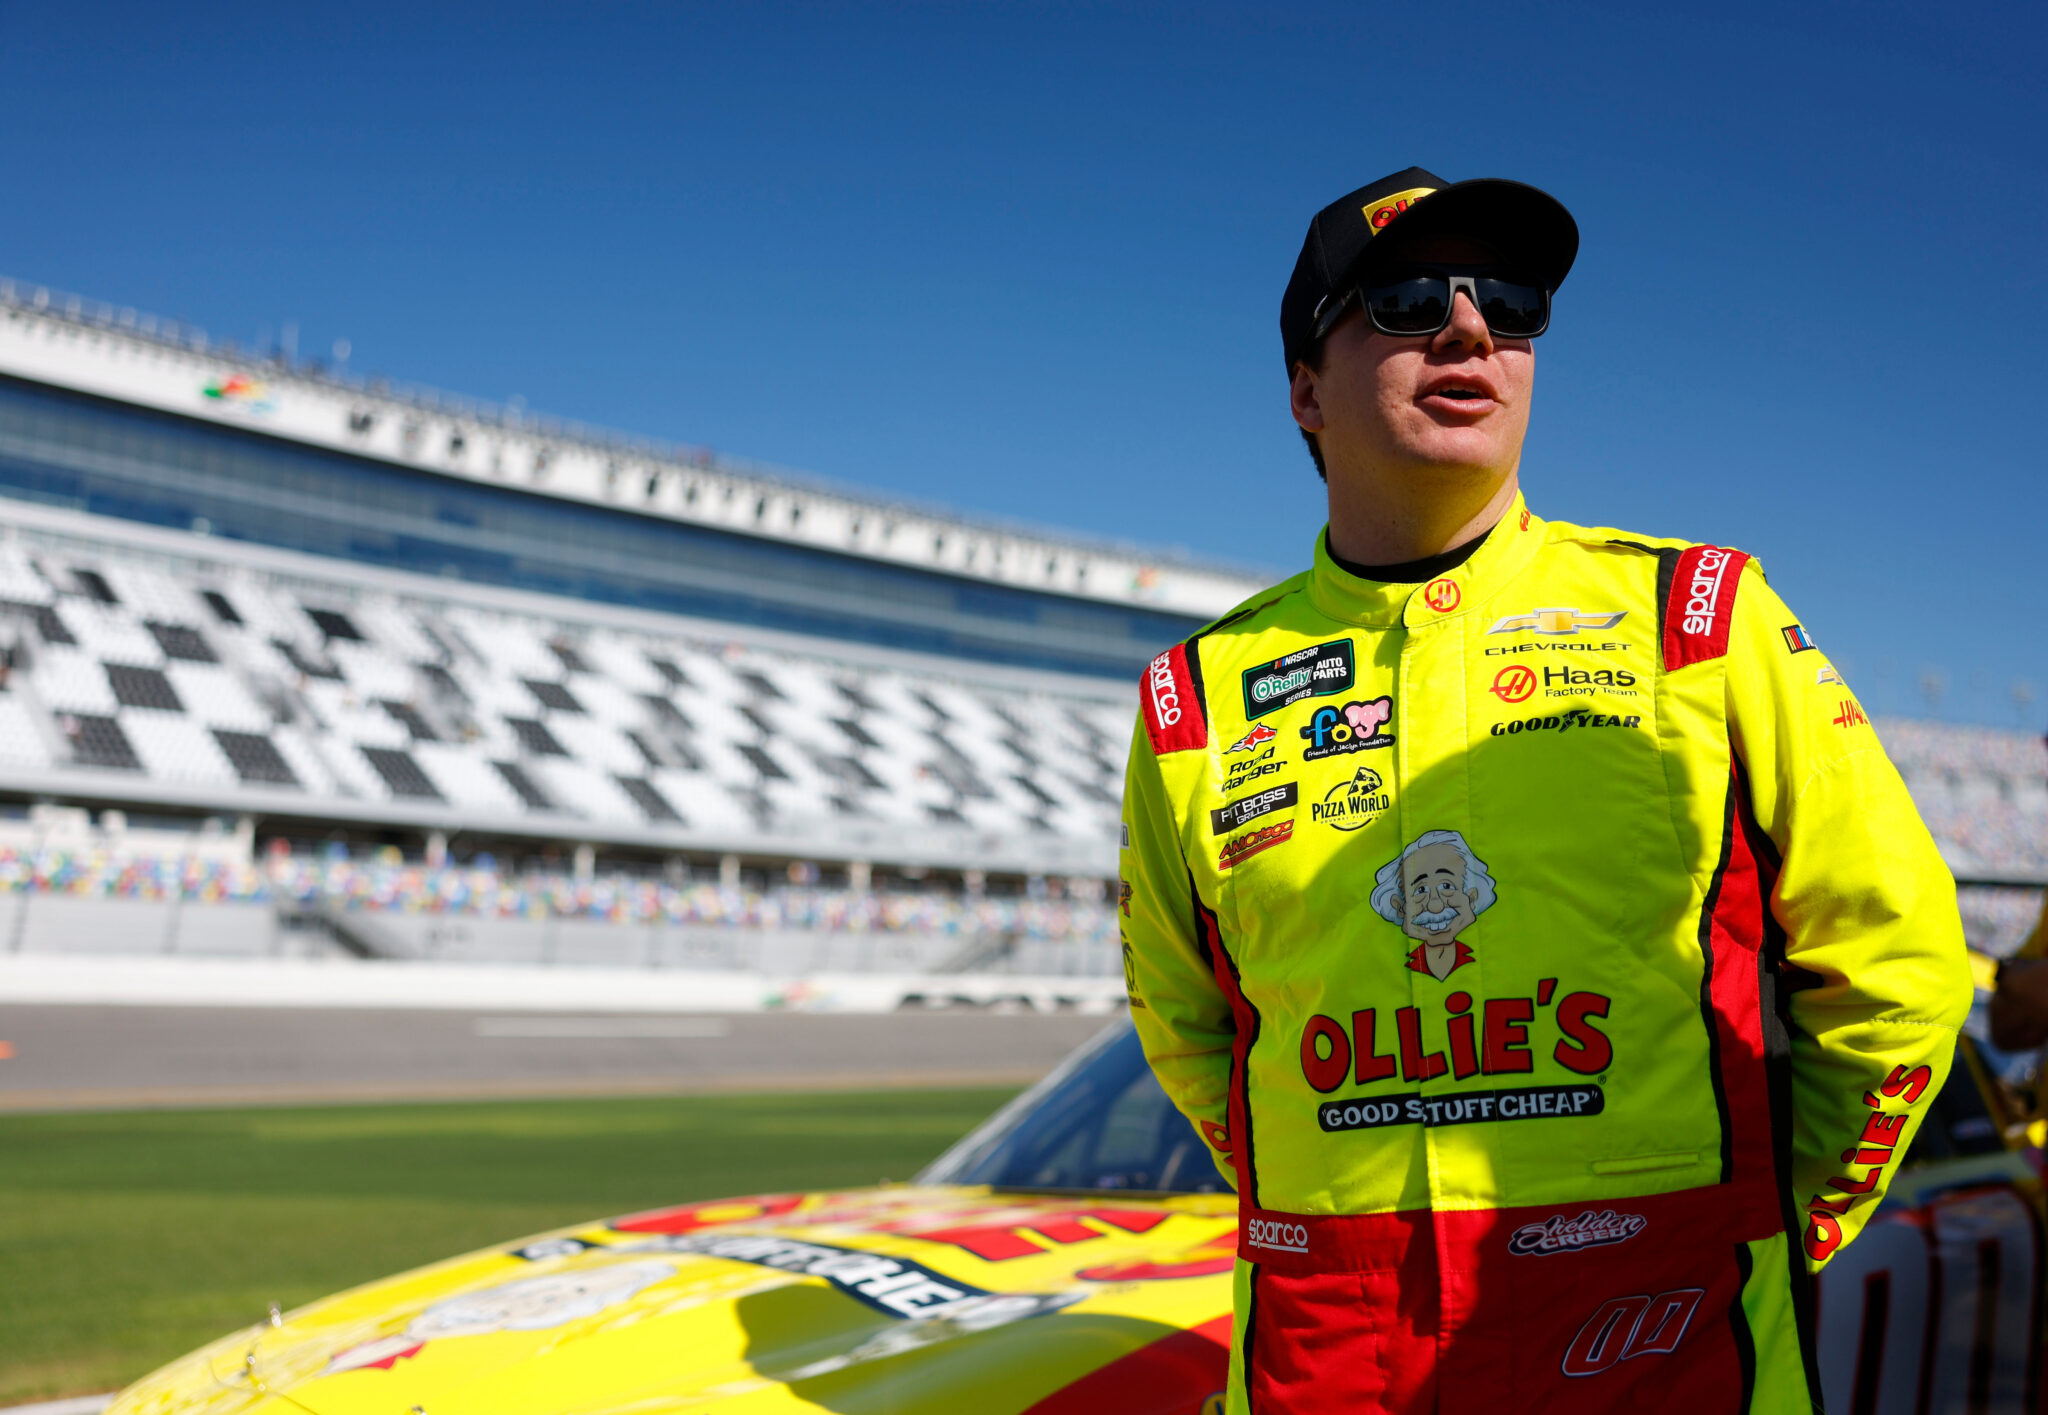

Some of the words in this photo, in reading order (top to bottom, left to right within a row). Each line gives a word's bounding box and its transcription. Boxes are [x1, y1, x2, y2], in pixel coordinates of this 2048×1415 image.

[1682, 549, 1728, 636] sparco
[1284, 647, 1319, 666] NASCAR
[1485, 643, 1632, 656] CHEVROLET
[1313, 667, 1347, 681] PARTS
[1316, 657, 1343, 670] AUTO
[1543, 666, 1636, 687] Haas
[1149, 651, 1182, 728] sparco
[1252, 666, 1313, 702] O'Reilly
[1284, 688, 1312, 706] SERIES
[1545, 686, 1596, 698] Factory
[1603, 687, 1638, 697] Team
[1490, 710, 1641, 737] GOODYEAR
[1228, 747, 1275, 775] Road
[1307, 748, 1329, 758] Friends
[1329, 745, 1336, 753] of
[1337, 742, 1358, 752] Jaclyn
[1221, 760, 1288, 792] Ranger
[1221, 802, 1241, 823] PIT
[1242, 787, 1287, 812] BOSS
[1236, 804, 1271, 825] GRILLS
[1312, 801, 1345, 822] PIZZA
[1349, 794, 1390, 814] WORLD
[1405, 1096, 1496, 1124] STUFF
[1248, 1217, 1308, 1252] sparco
[1517, 1212, 1642, 1249] Sheldon
[1540, 1229, 1627, 1250] CREED
[1561, 1287, 1706, 1377] 00
